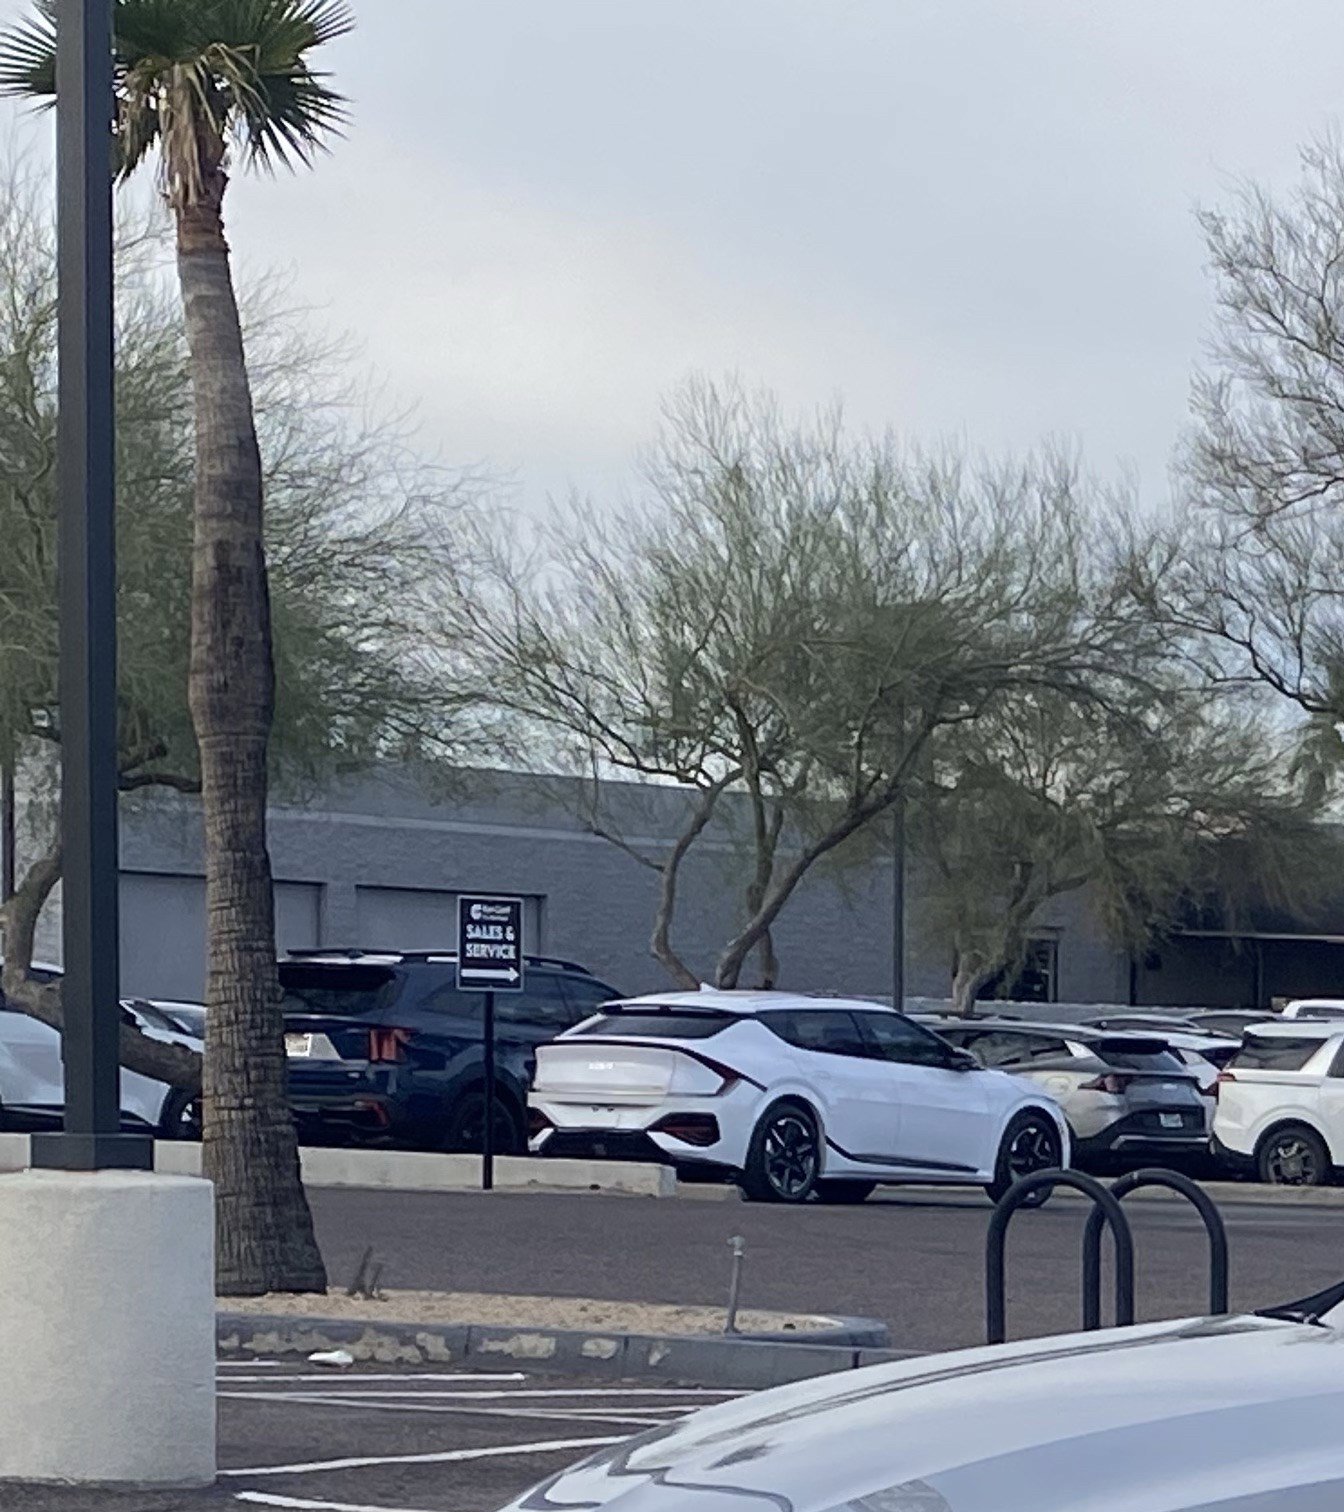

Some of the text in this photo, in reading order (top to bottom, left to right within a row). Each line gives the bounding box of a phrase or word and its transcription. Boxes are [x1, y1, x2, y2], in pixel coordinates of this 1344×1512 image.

[466, 924, 515, 941] SALES &
[465, 943, 516, 960] SERVICE
